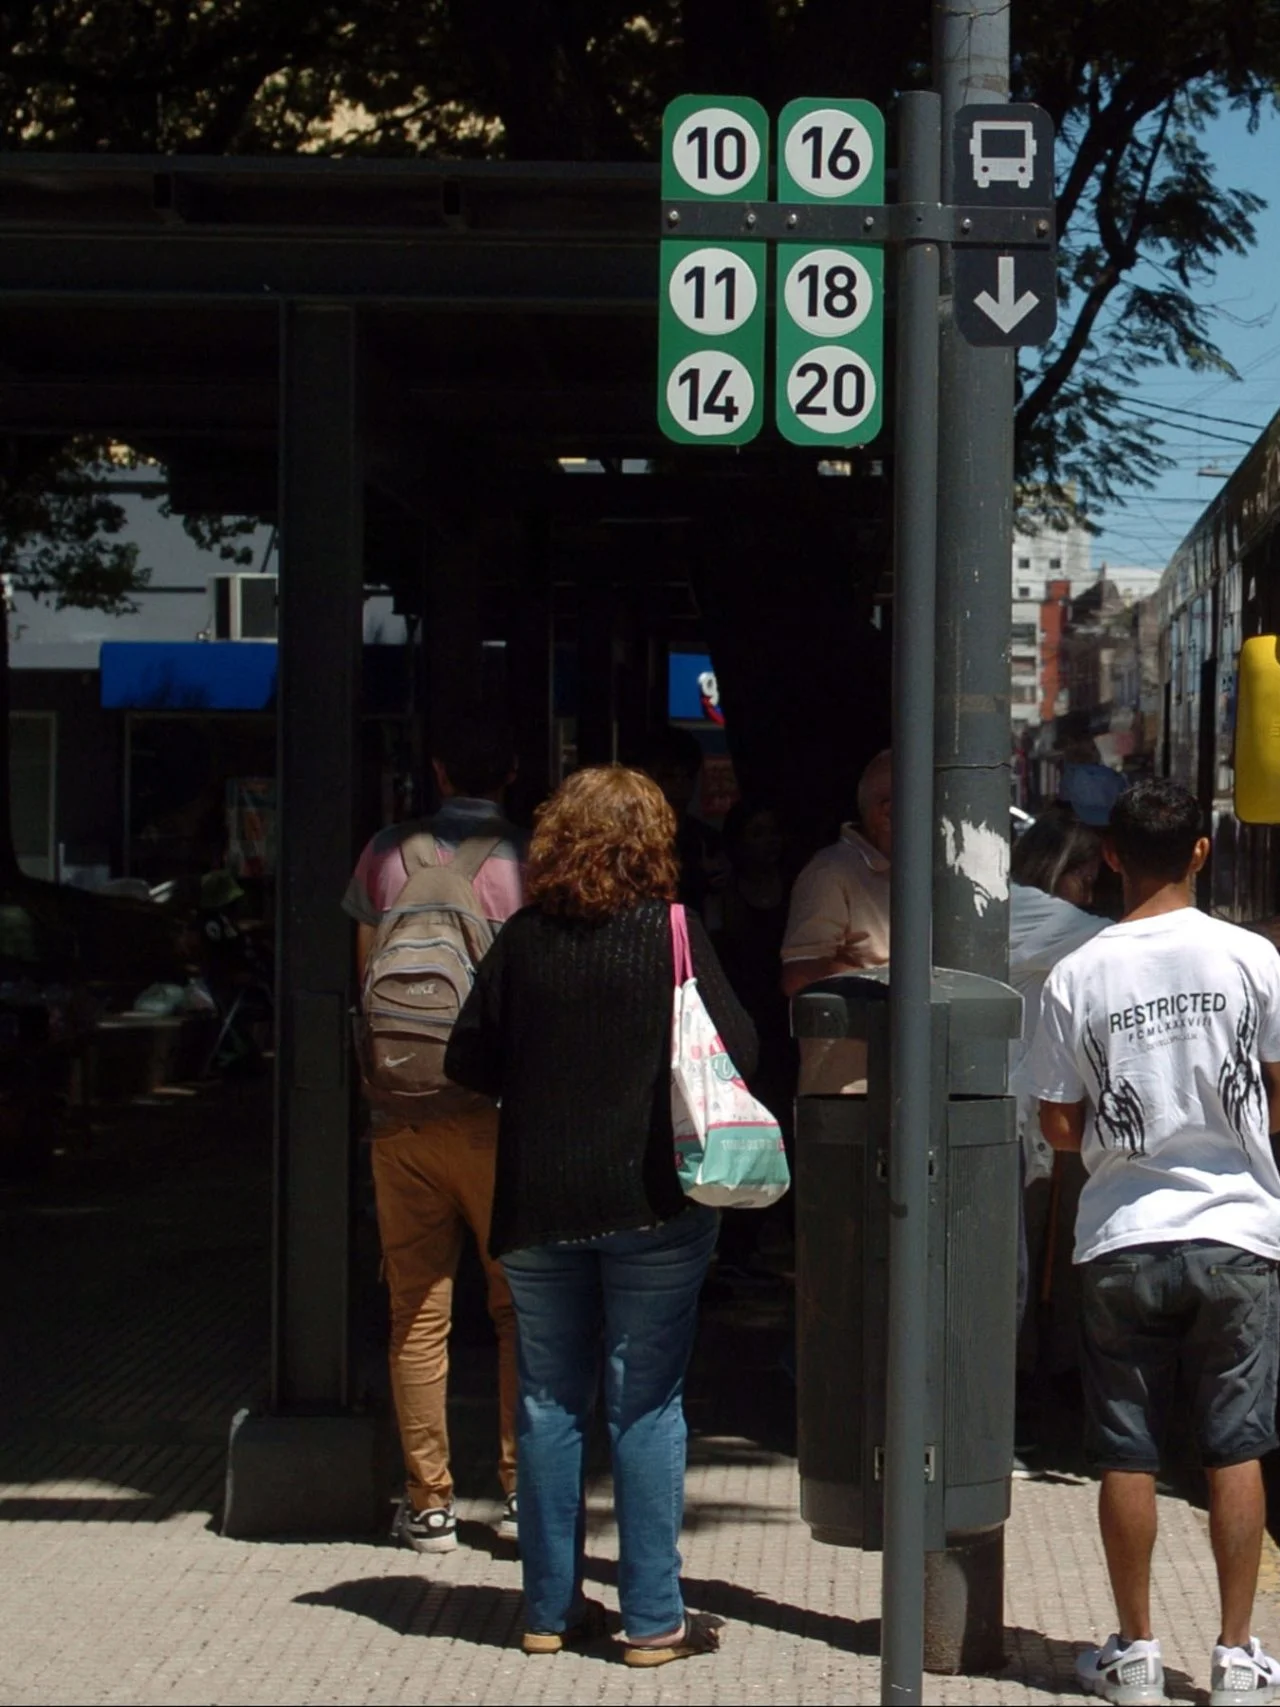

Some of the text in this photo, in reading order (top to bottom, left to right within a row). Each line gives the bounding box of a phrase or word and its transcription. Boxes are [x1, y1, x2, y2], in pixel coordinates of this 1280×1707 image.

[686, 126, 746, 180] 10
[801, 126, 861, 180] 16
[684, 266, 736, 320] 11
[798, 265, 858, 318] 18
[678, 367, 739, 422] 14
[795, 362, 866, 417] 20
[1109, 992, 1226, 1034] RESTRICTED
